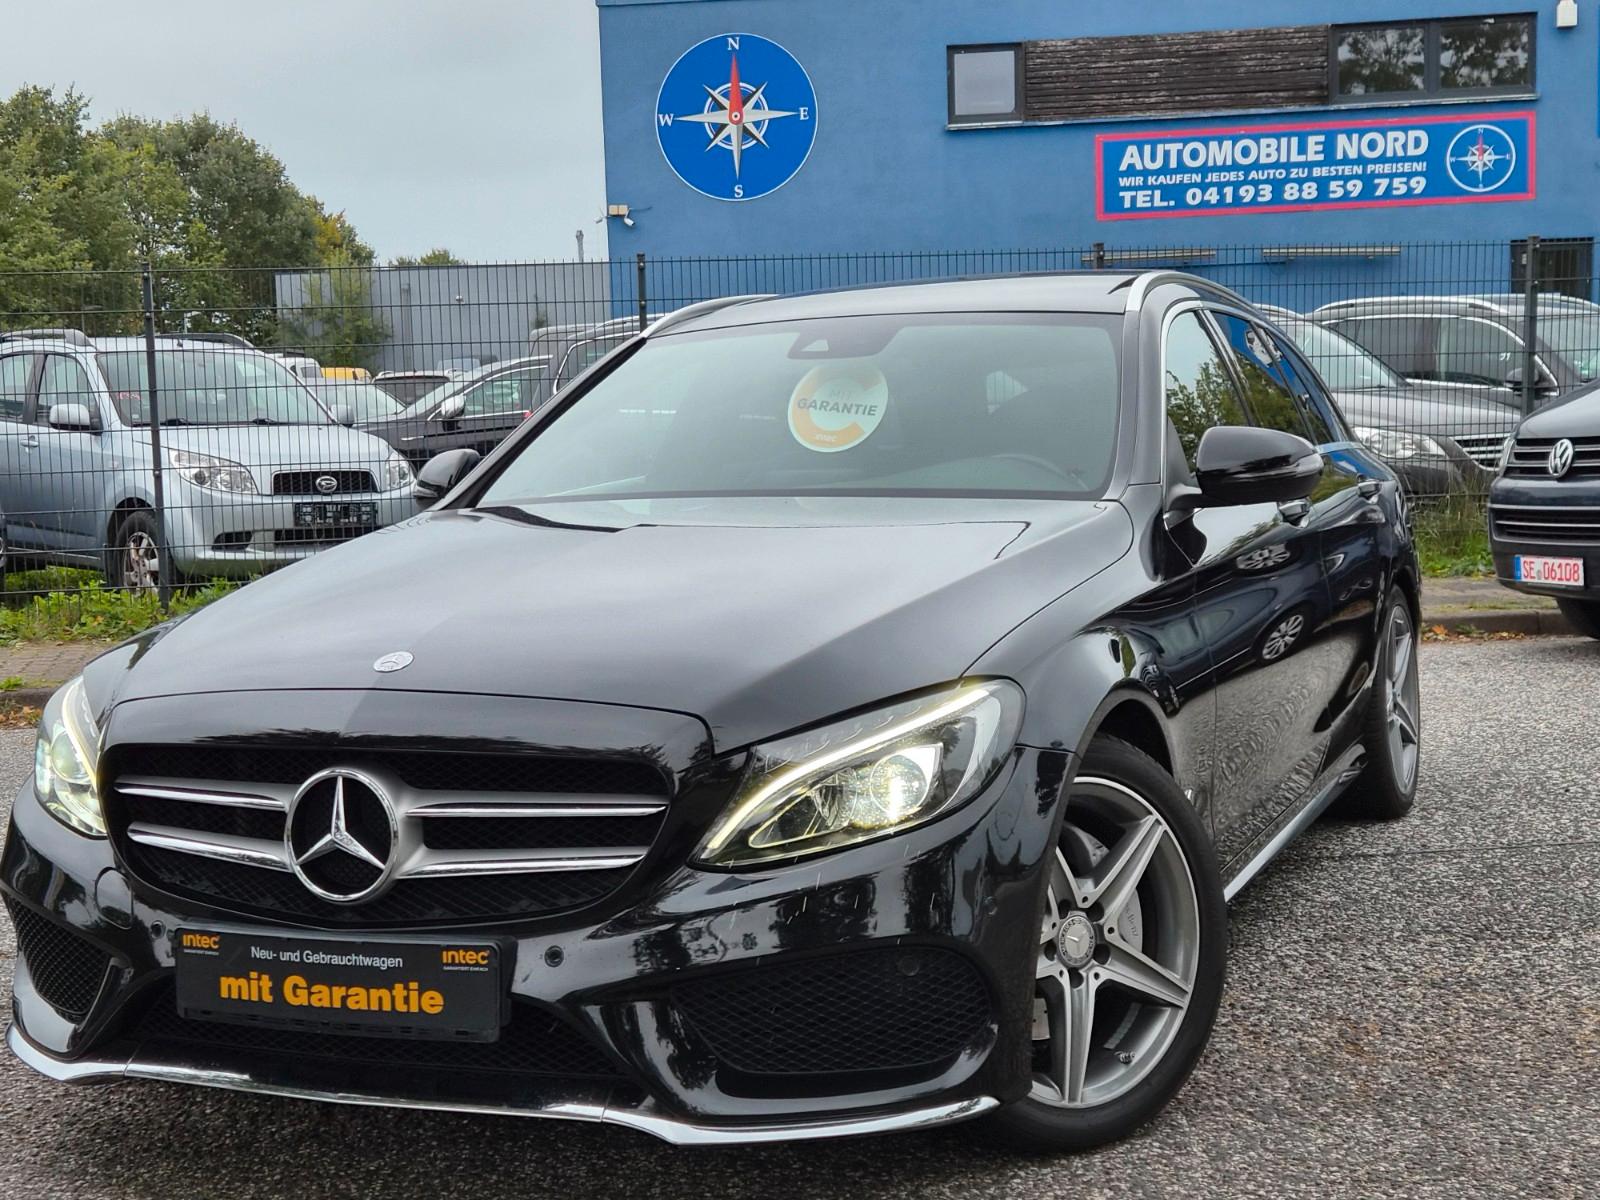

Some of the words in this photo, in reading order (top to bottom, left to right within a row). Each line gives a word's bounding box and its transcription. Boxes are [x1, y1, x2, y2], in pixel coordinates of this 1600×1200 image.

[727, 37, 740, 50] N
[658, 113, 674, 127] W
[799, 107, 809, 120] E
[1119, 135, 1326, 172] AUTOMOBILE
[1336, 130, 1429, 160] NORD
[1119, 176, 1144, 187] WIR
[1147, 173, 1202, 186] KAUFEN
[1205, 171, 1245, 183] JEDES
[1248, 169, 1287, 180] AUTO
[1290, 168, 1308, 178] ZU
[1312, 165, 1363, 177] BESTEN
[1367, 161, 1427, 174] PREISEN!
[734, 184, 744, 198] S
[1119, 190, 1175, 208] TEL.
[1186, 184, 1273, 205] 04193
[1283, 181, 1318, 200] 88
[1329, 179, 1363, 198] 59
[1374, 176, 1427, 196] 759
[797, 397, 878, 416] GARANTIE
[1523, 560, 1536, 579] SE
[1543, 561, 1580, 583] 06108
[183, 934, 219, 949] intec
[250, 946, 277, 959] Neu-
[279, 950, 301, 962] und
[303, 951, 403, 970] Gebrauchtwagen
[442, 949, 488, 965] intec
[219, 970, 274, 1003] mit
[283, 975, 445, 1014] Garantie
